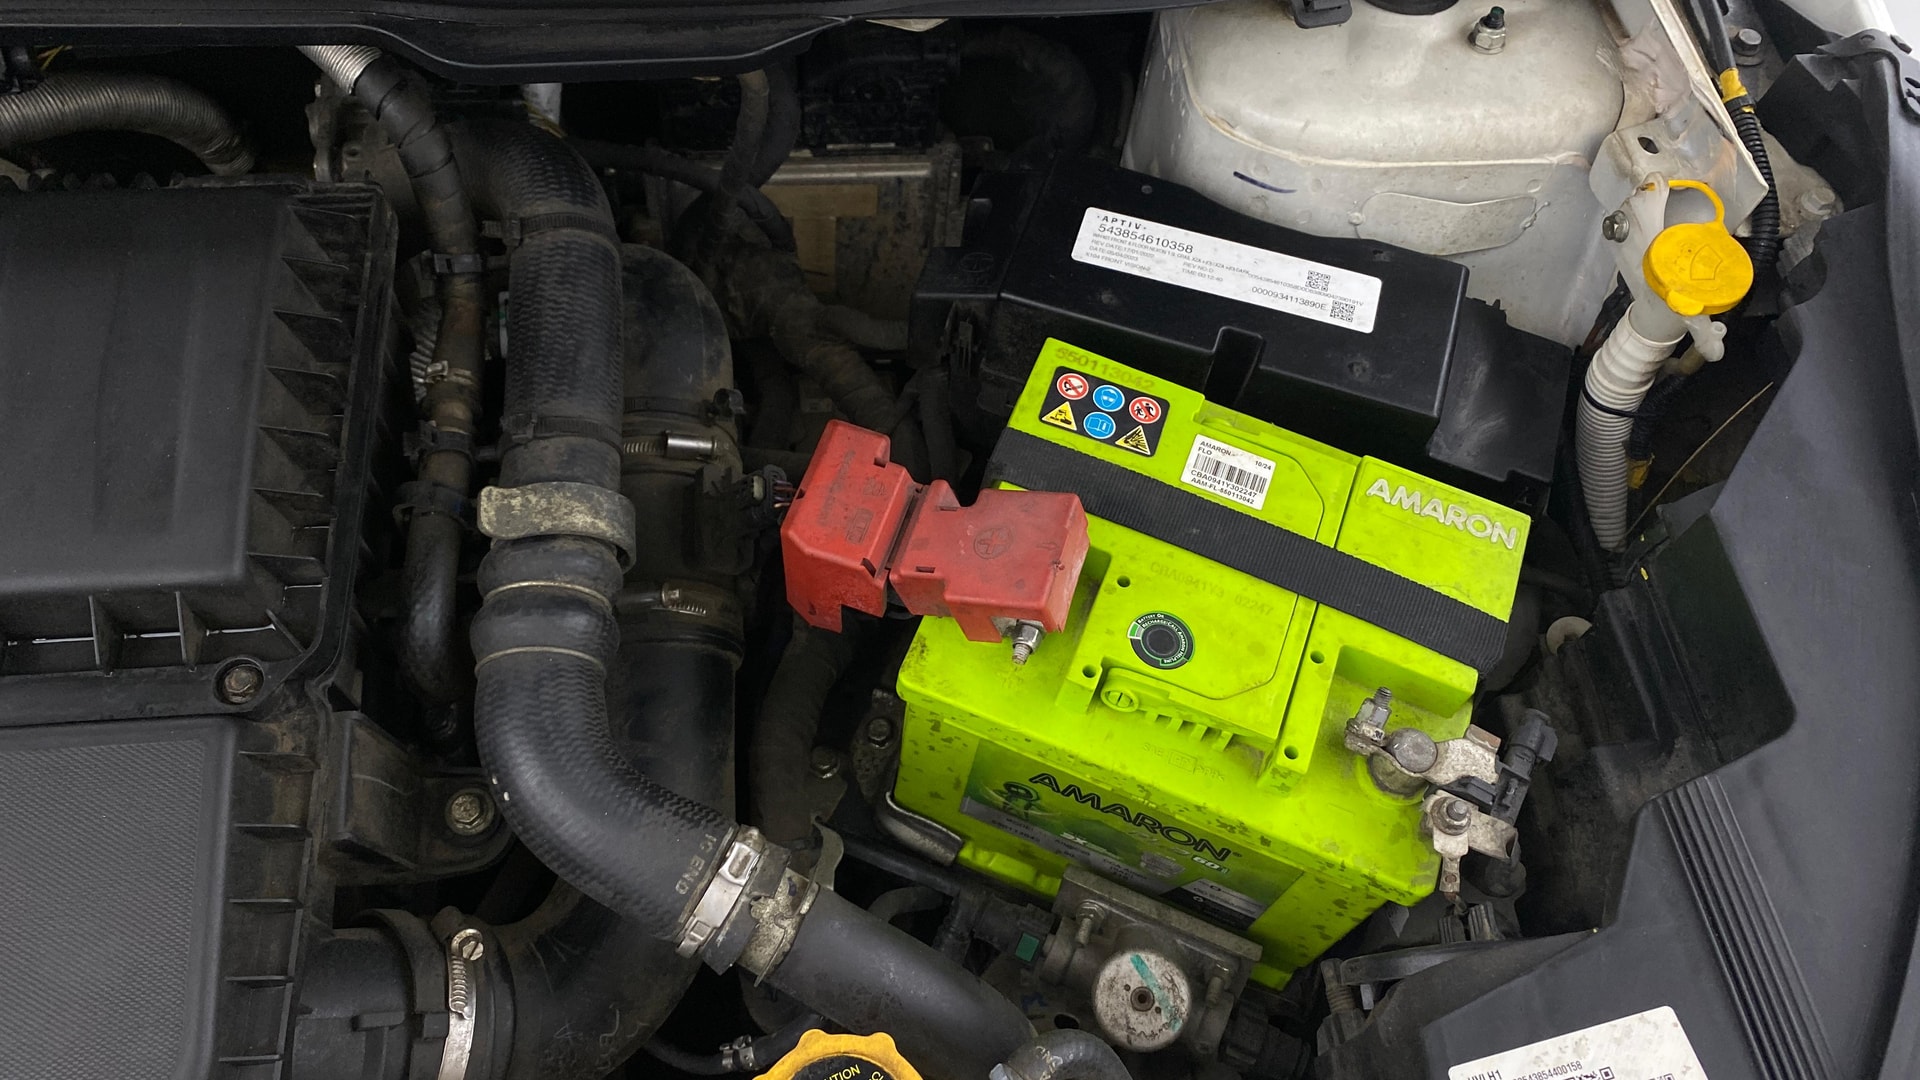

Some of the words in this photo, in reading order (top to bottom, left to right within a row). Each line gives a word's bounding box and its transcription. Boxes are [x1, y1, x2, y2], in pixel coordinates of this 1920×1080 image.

[1101, 215, 1142, 230] APTIV
[1098, 223, 1194, 254] 543854610358
[1198, 447, 1213, 456] FLO
[1200, 441, 1232, 456] AMARON
[1255, 460, 1272, 471] 10/24
[1191, 469, 1258, 498] CBA0941Y302247
[1191, 477, 1255, 504] AAM-FL-550113042
[1365, 478, 1517, 550] AMARON
[1028, 772, 1233, 862] AMARON
[824, 1064, 861, 1080] TION
